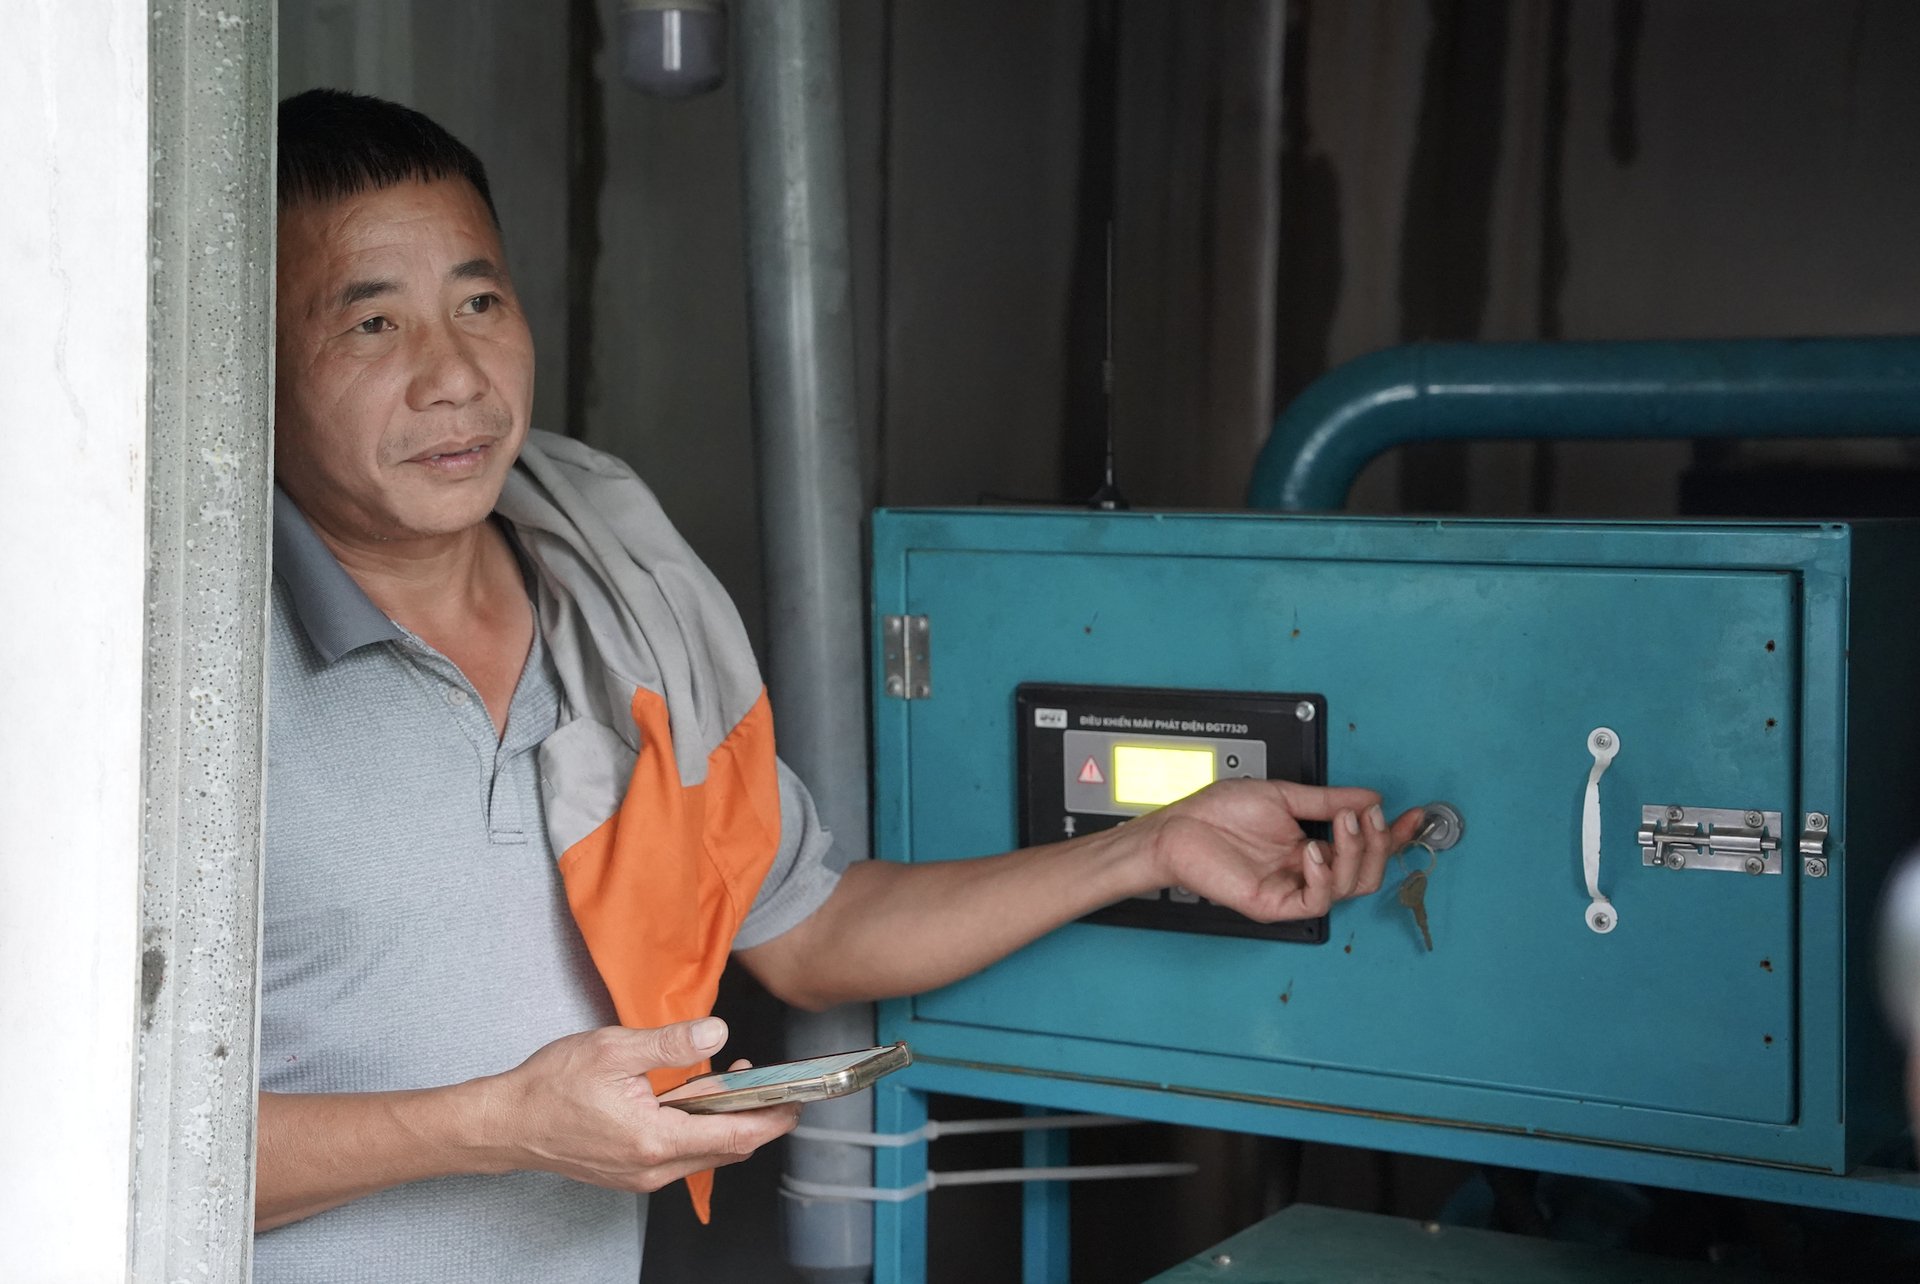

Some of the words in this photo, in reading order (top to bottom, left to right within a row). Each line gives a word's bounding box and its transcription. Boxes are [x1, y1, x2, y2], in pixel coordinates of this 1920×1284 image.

[1133, 716, 1155, 730] MÁY
[1155, 718, 1180, 731] PHÁT
[1181, 719, 1205, 732] ĐIỆN
